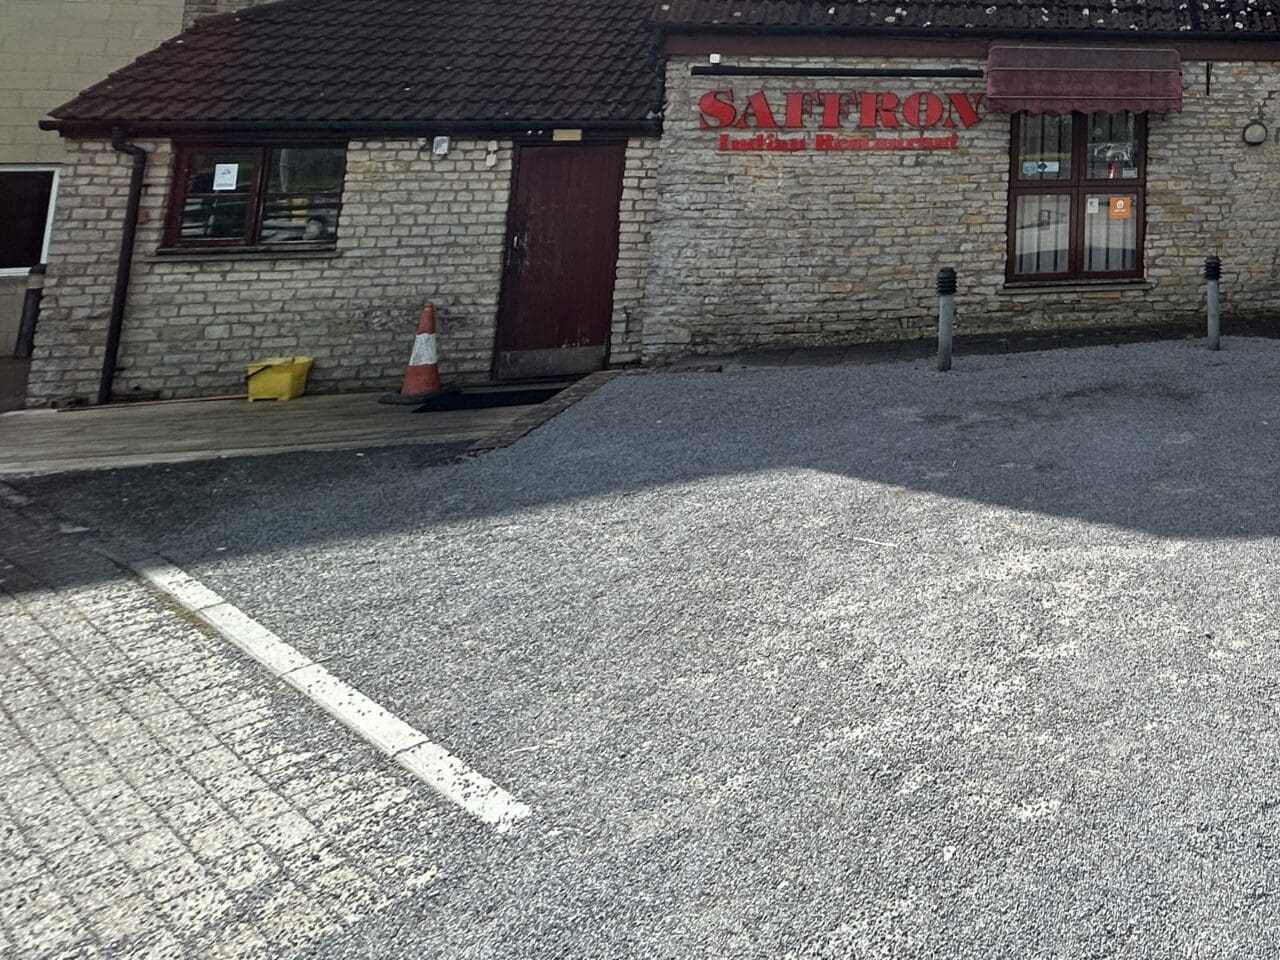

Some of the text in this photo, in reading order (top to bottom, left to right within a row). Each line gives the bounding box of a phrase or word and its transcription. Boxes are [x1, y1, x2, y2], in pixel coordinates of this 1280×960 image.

[698, 89, 986, 130] SAFFRON
[718, 132, 959, 152] Indian Restaurant
